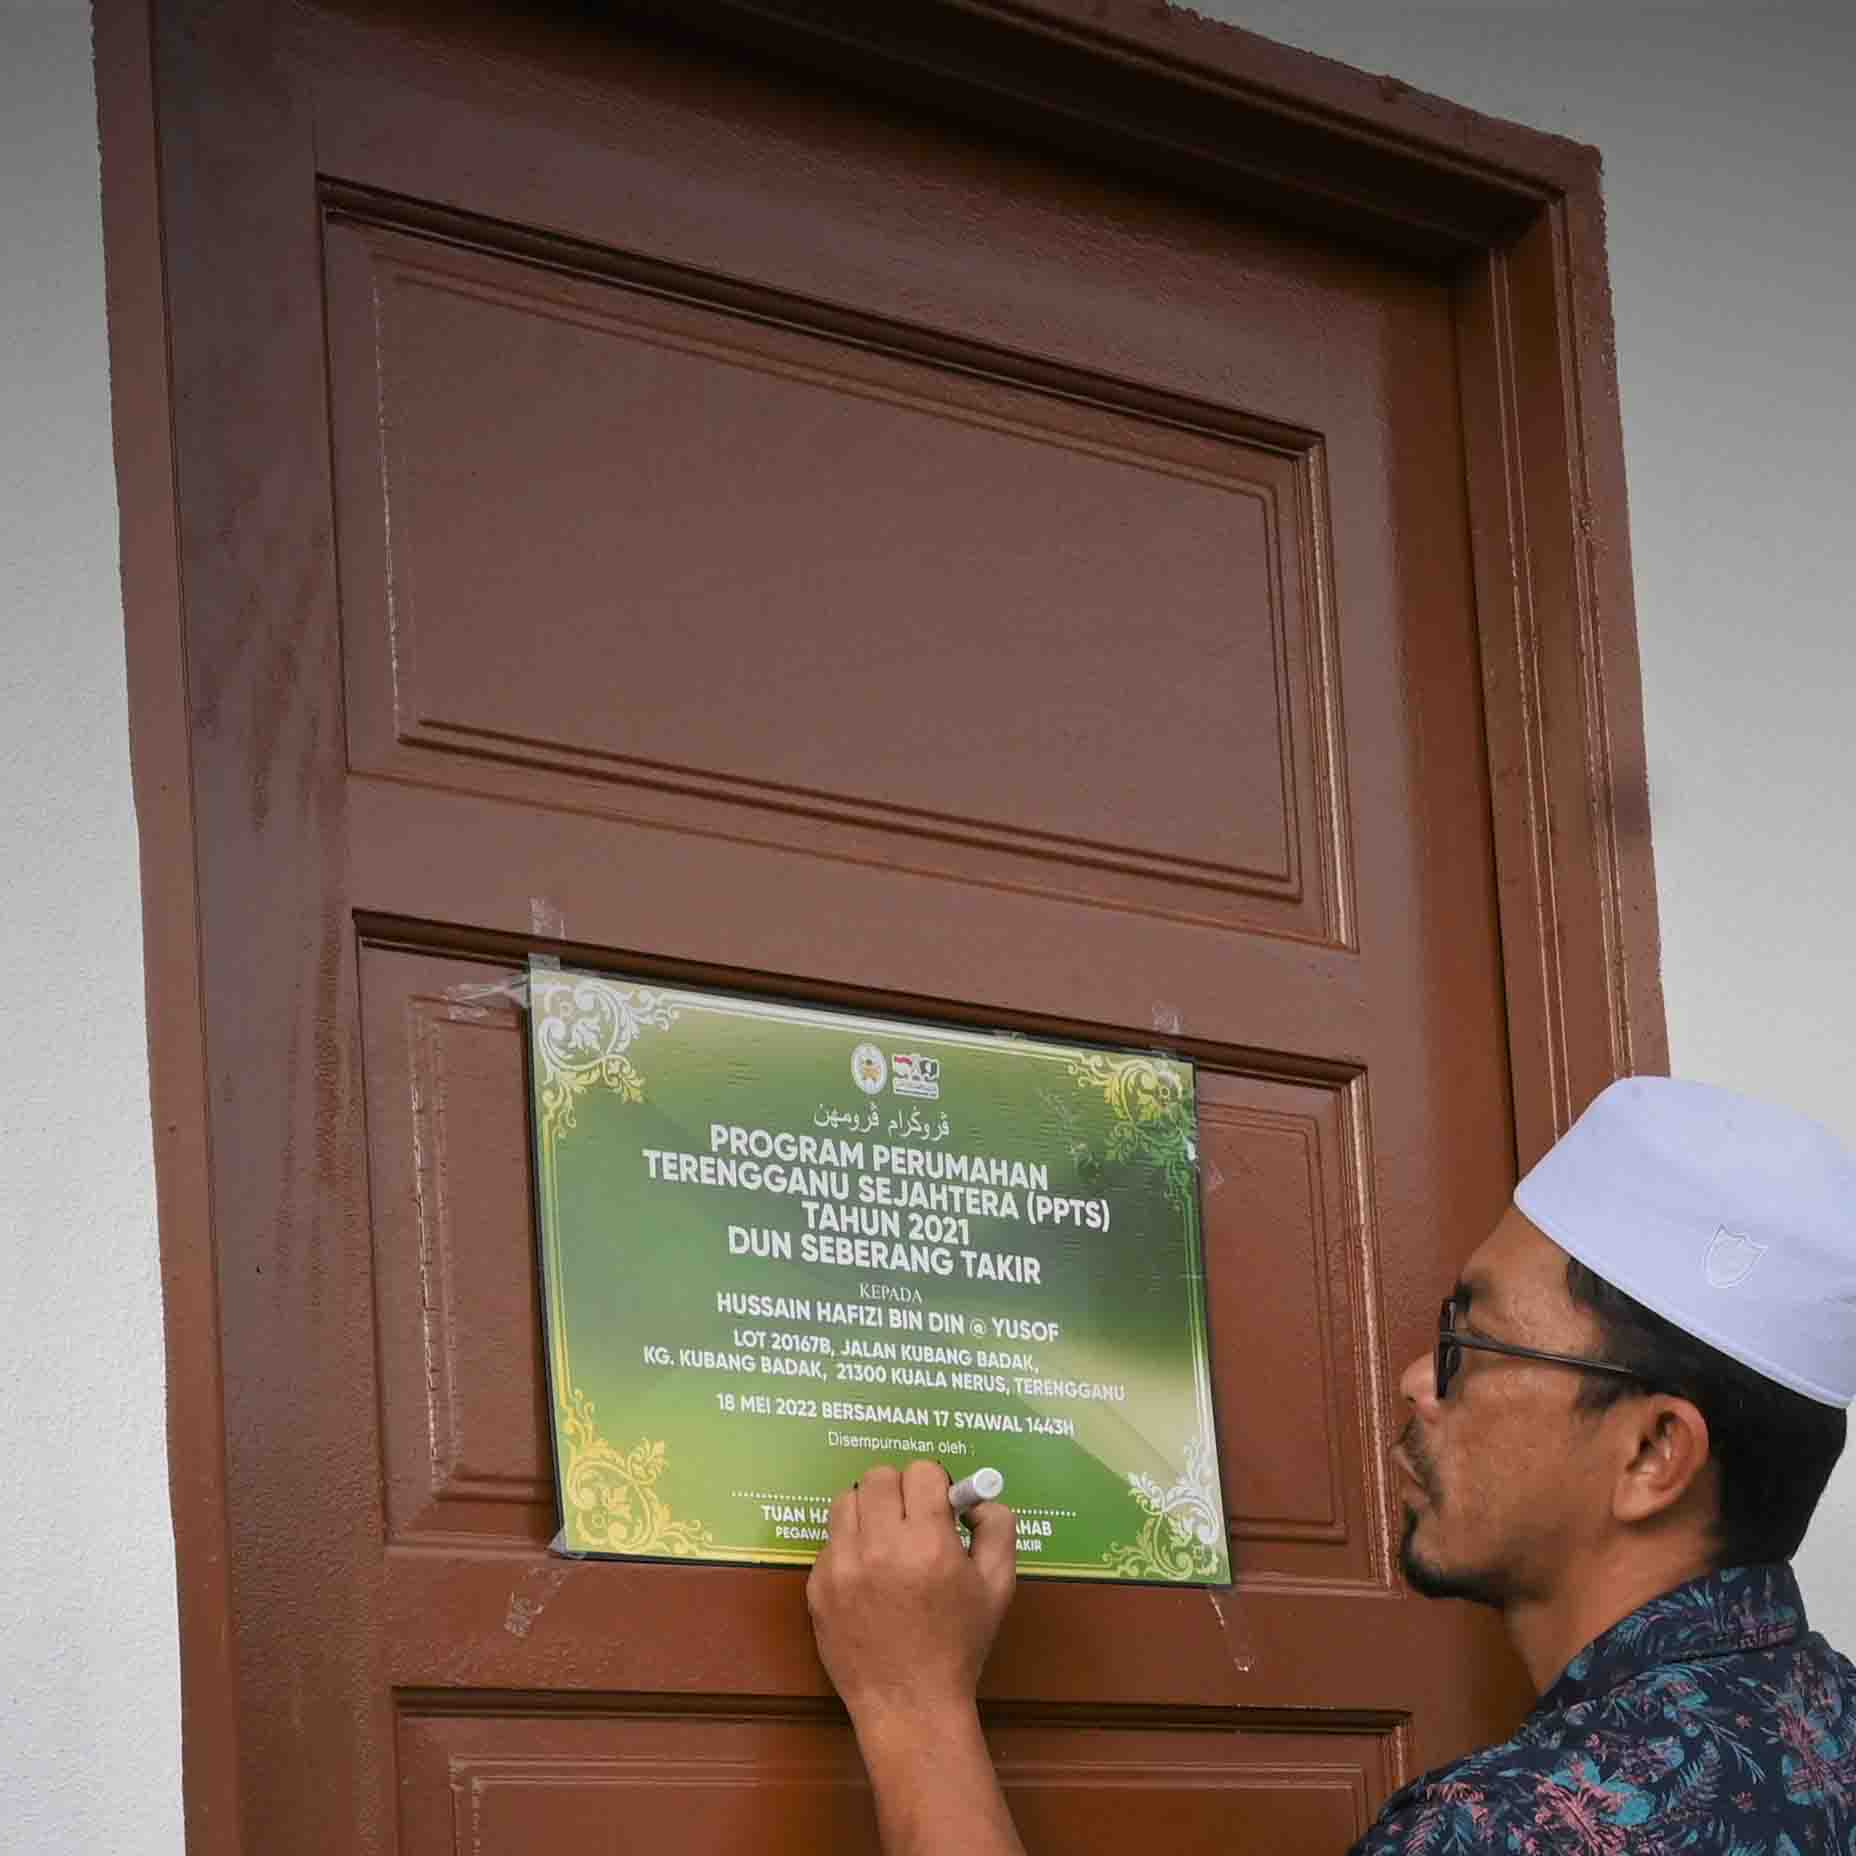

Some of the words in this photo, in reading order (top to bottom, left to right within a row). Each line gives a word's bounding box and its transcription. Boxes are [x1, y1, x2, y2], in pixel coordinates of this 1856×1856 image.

[709, 1122, 865, 1171] PROGRAM
[871, 1143, 1049, 1191] PERUMAHAN
[642, 1148, 850, 1200] TERENGGANU
[857, 1175, 1020, 1220] SEJAHTERA
[1026, 1191, 1111, 1233] (PPTS)
[800, 1201, 901, 1239] TAHUN
[907, 1213, 971, 1246] 2021
[727, 1224, 793, 1260] DUN
[800, 1233, 955, 1276] SEBERANG
[959, 1250, 1042, 1285] TAKIR
[859, 1282, 924, 1304] KEPADA
[716, 1291, 812, 1322] HUSSAIN
[816, 1301, 884, 1328] HAFIZI
[888, 1307, 924, 1332] BIN
[928, 1311, 965, 1337] DIN
[967, 1317, 988, 1339] @
[991, 1316, 1060, 1343] YUSOF
[643, 1345, 675, 1366] KG.
[679, 1348, 757, 1374] KUBANG
[759, 1356, 828, 1384] BADAK,
[835, 1361, 888, 1384] 21300
[890, 1366, 948, 1388] KUALA
[950, 1371, 1011, 1398] NERUS,
[1013, 1375, 1128, 1402] TERENGGANU
[732, 1328, 769, 1349] LOT
[771, 1332, 836, 1358] 20167B,
[840, 1338, 897, 1361] JALAN
[900, 1343, 974, 1367] KUBANG
[976, 1349, 1041, 1374] BADAK,
[716, 1392, 736, 1412] 18
[740, 1394, 771, 1416] MEI
[775, 1397, 818, 1419] 2022
[821, 1401, 930, 1427] BERSAMAAN
[932, 1408, 951, 1428] 17
[953, 1410, 1024, 1434] SYAWAL
[1024, 1415, 1076, 1437] 1443H
[827, 1430, 935, 1455] Disempurnakan
[937, 1438, 968, 1456] oleh
[759, 1503, 806, 1523] TUAN
[775, 1525, 831, 1542] PEGAWA
[1015, 1538, 1043, 1553] AKIR
